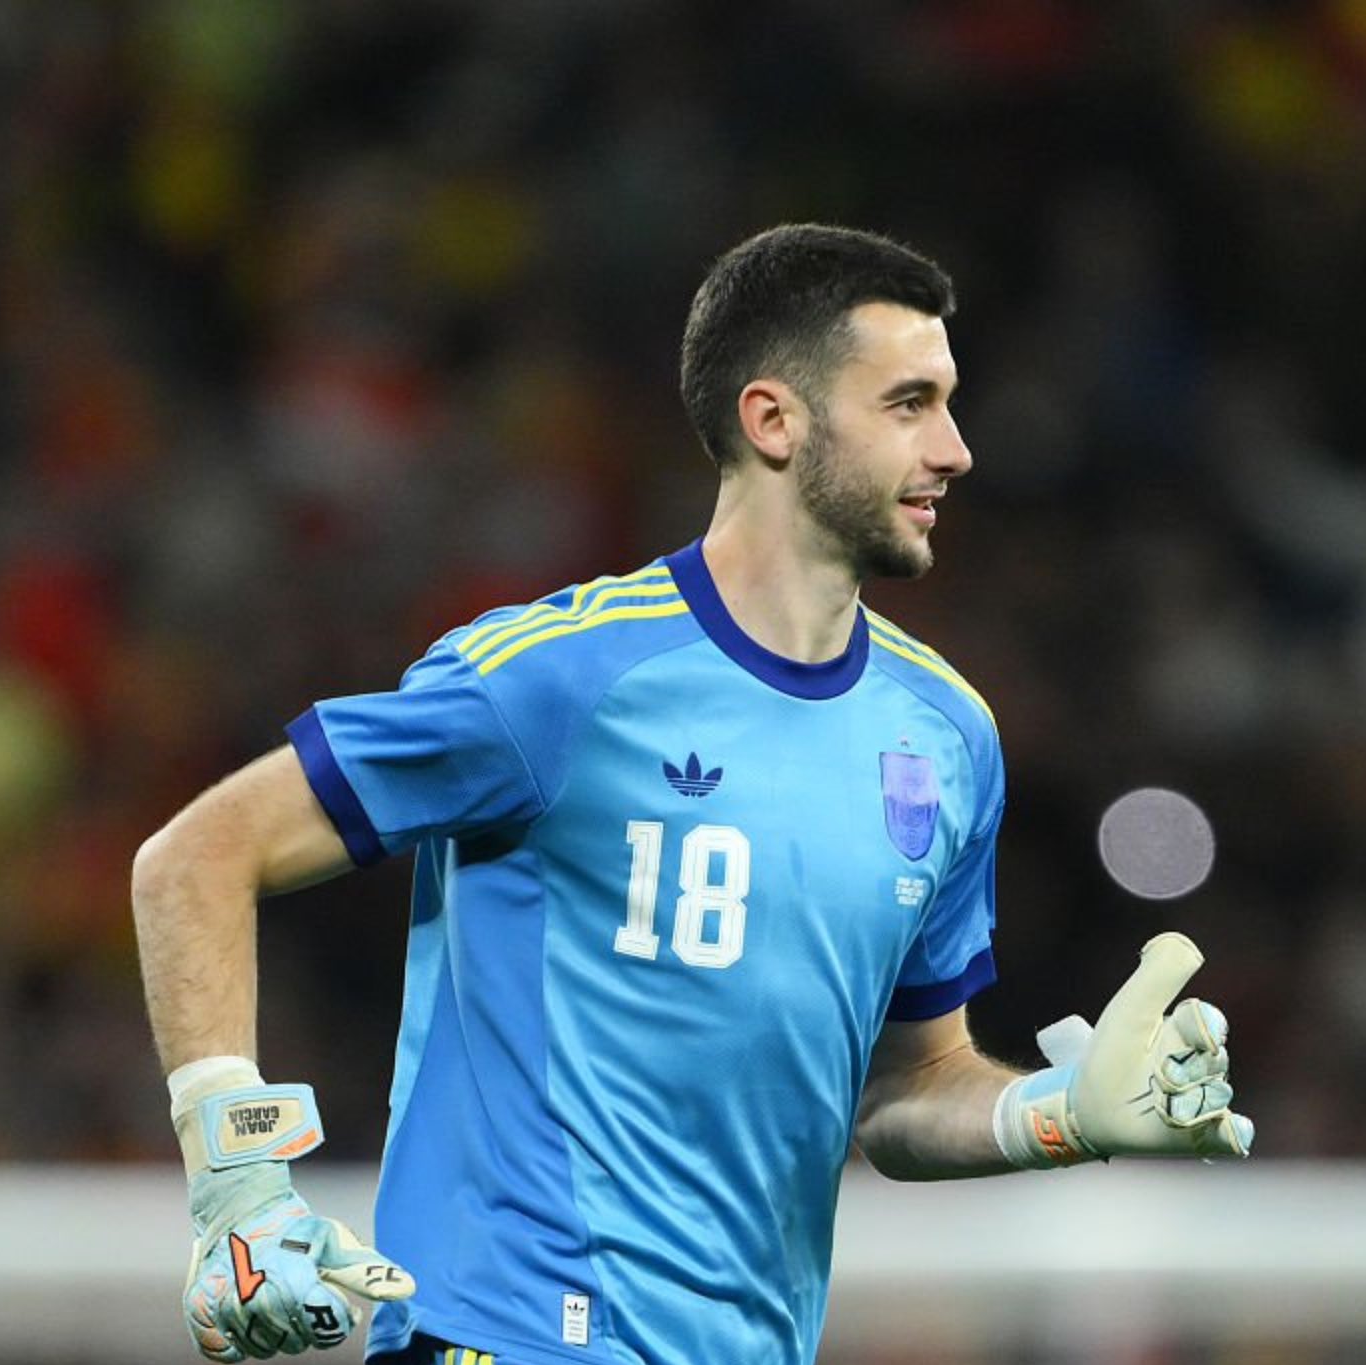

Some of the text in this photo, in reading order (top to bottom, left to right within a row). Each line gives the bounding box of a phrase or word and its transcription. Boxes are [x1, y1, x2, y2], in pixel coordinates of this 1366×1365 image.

[614, 820, 751, 969] 18
[228, 1105, 280, 1125] GARCIA
[234, 1119, 277, 1137] JOAN
